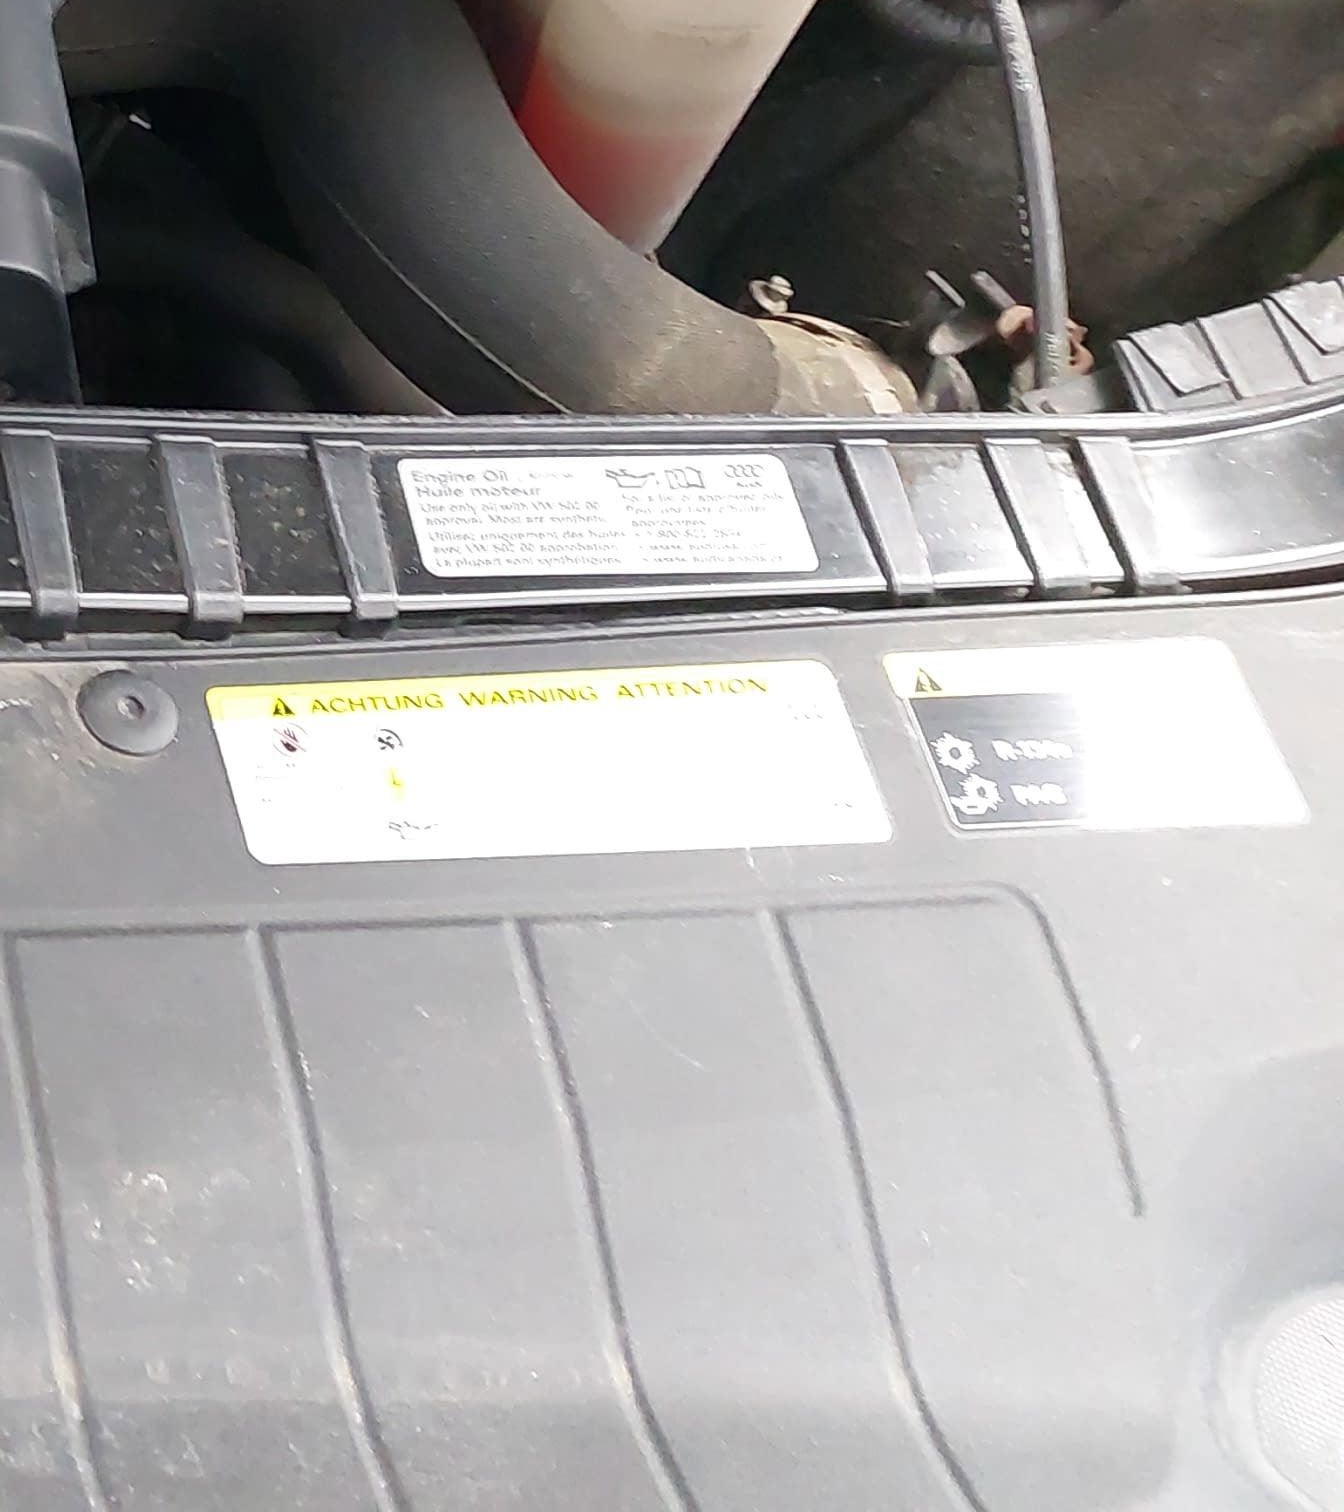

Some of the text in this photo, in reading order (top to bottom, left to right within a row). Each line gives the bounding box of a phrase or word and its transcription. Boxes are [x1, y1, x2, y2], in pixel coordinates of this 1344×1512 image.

[410, 469, 509, 485] Engine Oil
[416, 485, 541, 498] Huile moteur
[310, 677, 769, 716] ACHTUNG WARNING ATTENTION
